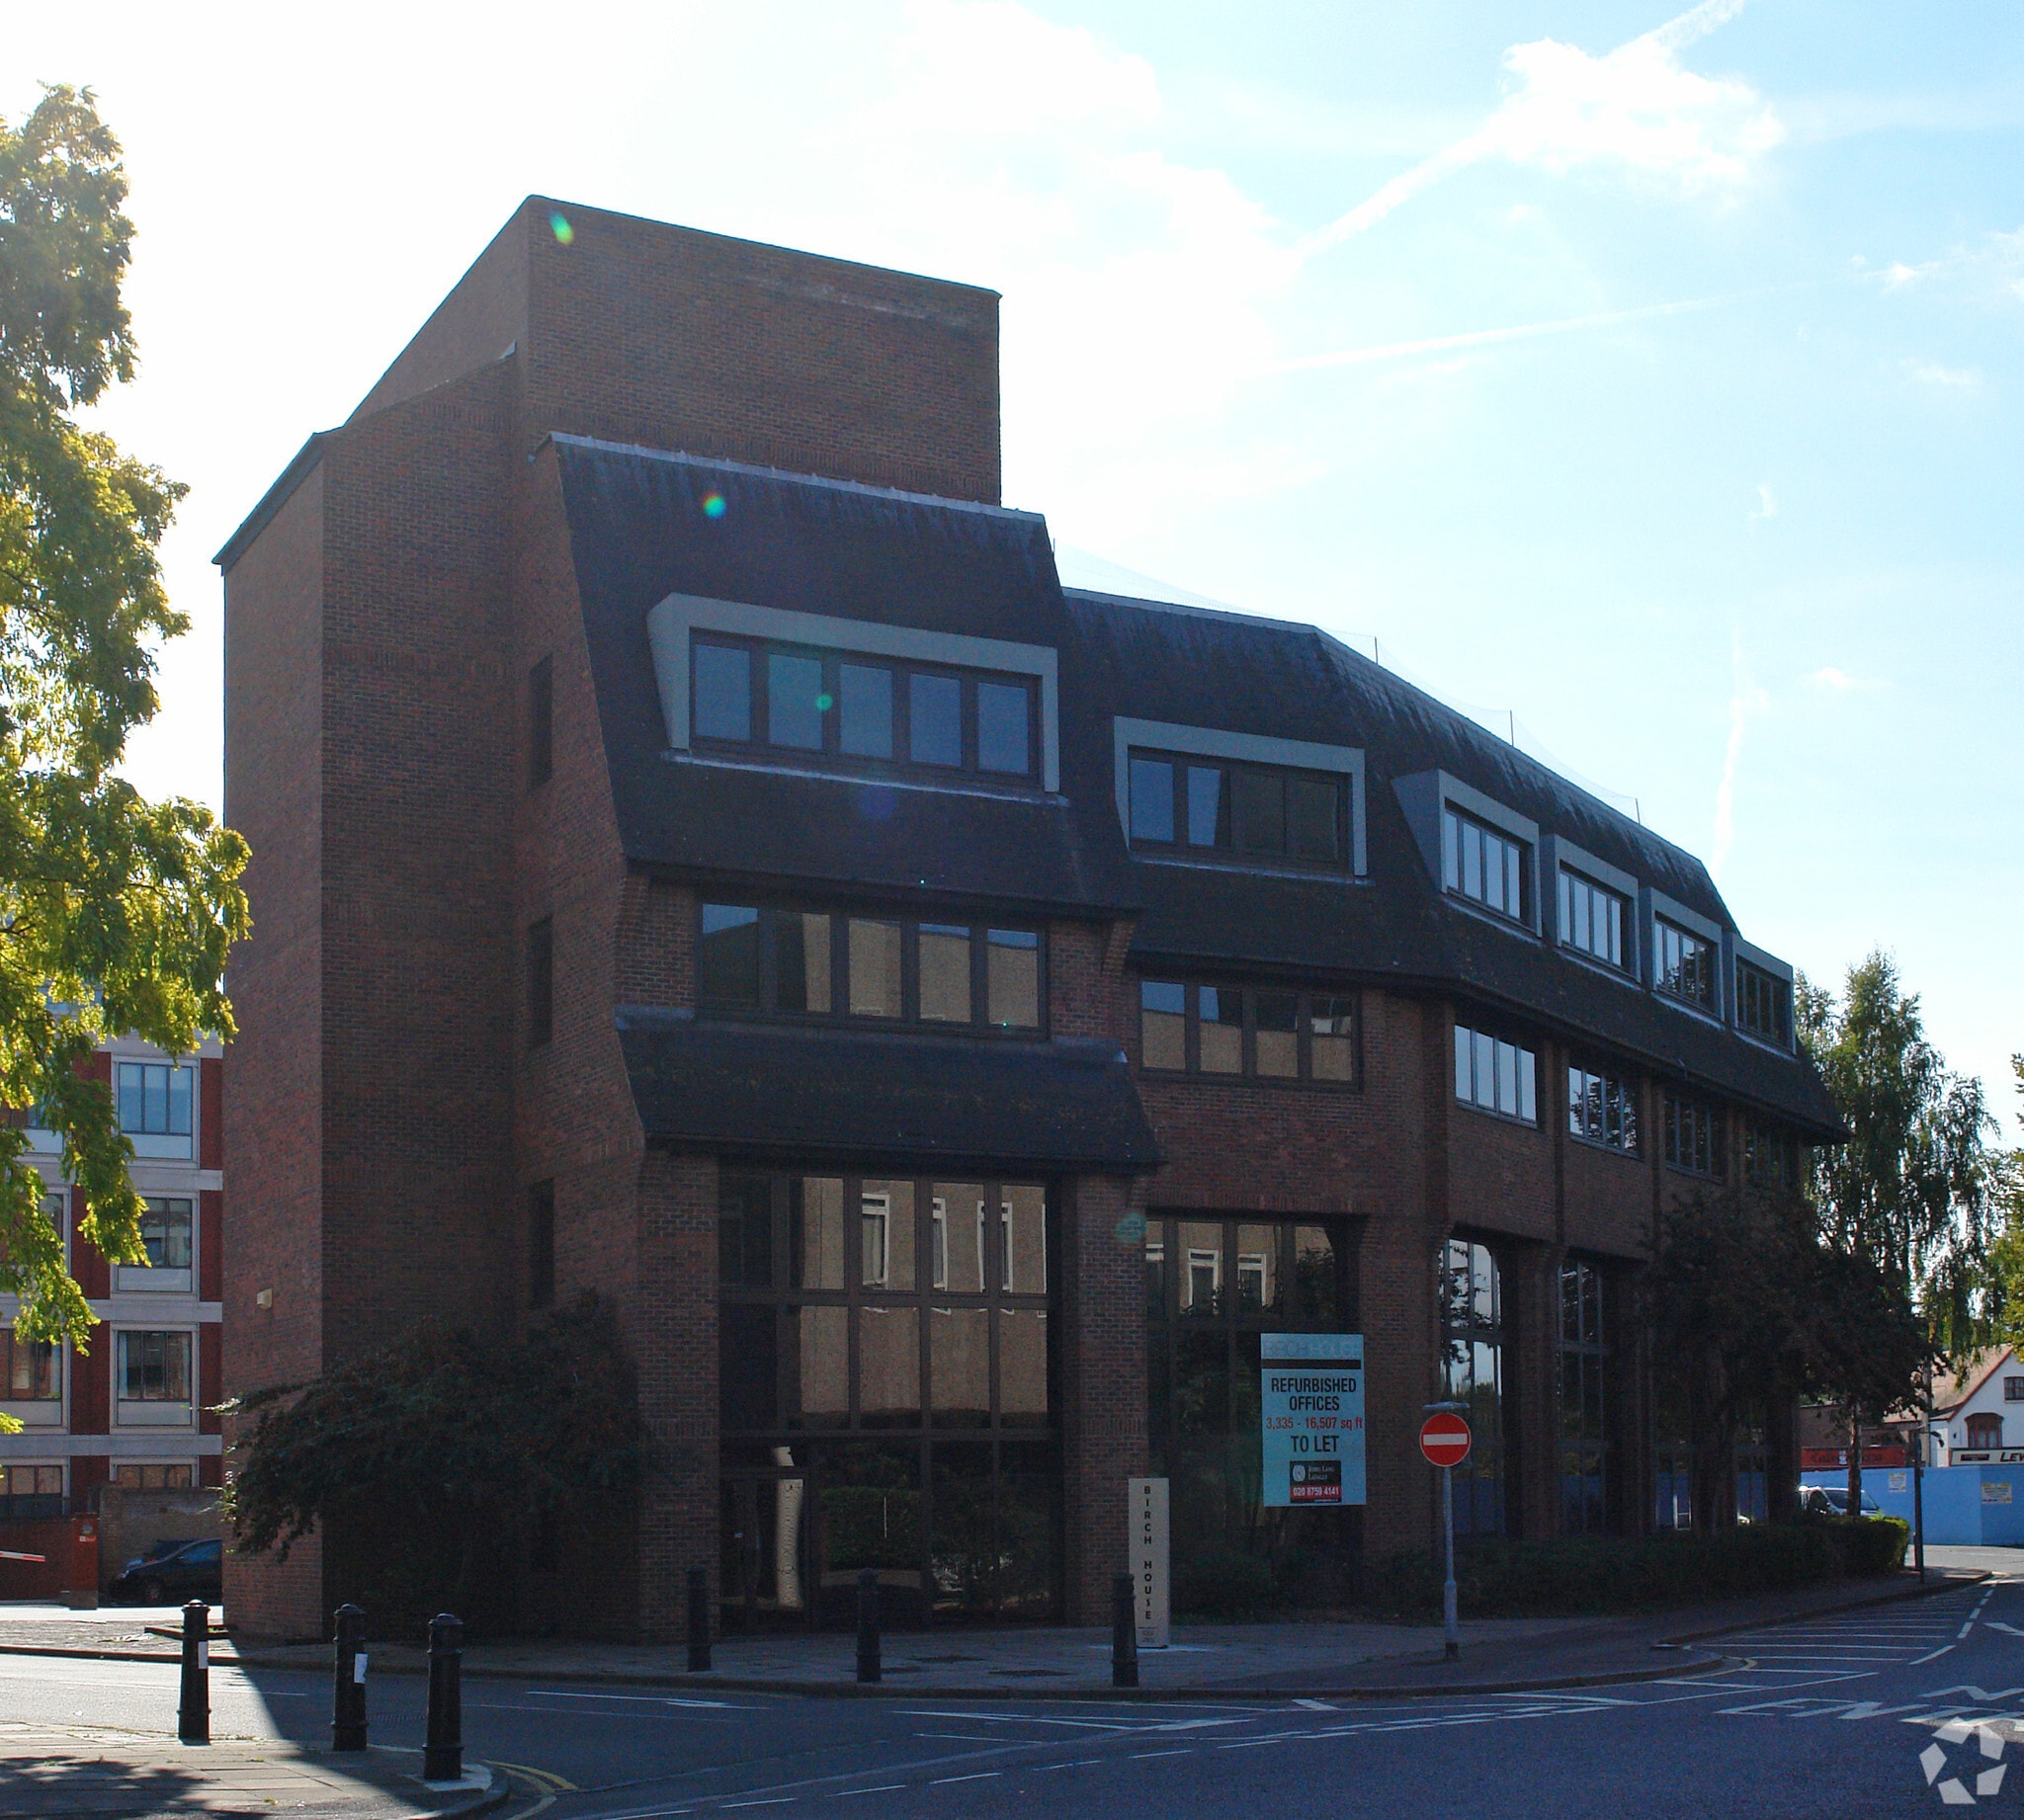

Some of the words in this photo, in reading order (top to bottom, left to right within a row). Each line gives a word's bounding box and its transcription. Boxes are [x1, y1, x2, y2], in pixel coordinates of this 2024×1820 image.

[1271, 1377, 1357, 1393] REFURBISHED
[1289, 1395, 1340, 1411] OFFICES
[1266, 1416, 1294, 1430] 3,335
[1305, 1416, 1337, 1431] 16,507
[1340, 1419, 1353, 1432] sq
[1355, 1416, 1363, 1429] ft
[1290, 1435, 1309, 1452] TO
[1313, 1435, 1340, 1452] LET
[1293, 1487, 1306, 1496] 020
[1323, 1486, 1339, 1495] 4141
[1143, 1485, 1152, 1545] BIRCH
[1143, 1560, 1152, 1619] HOUSE
